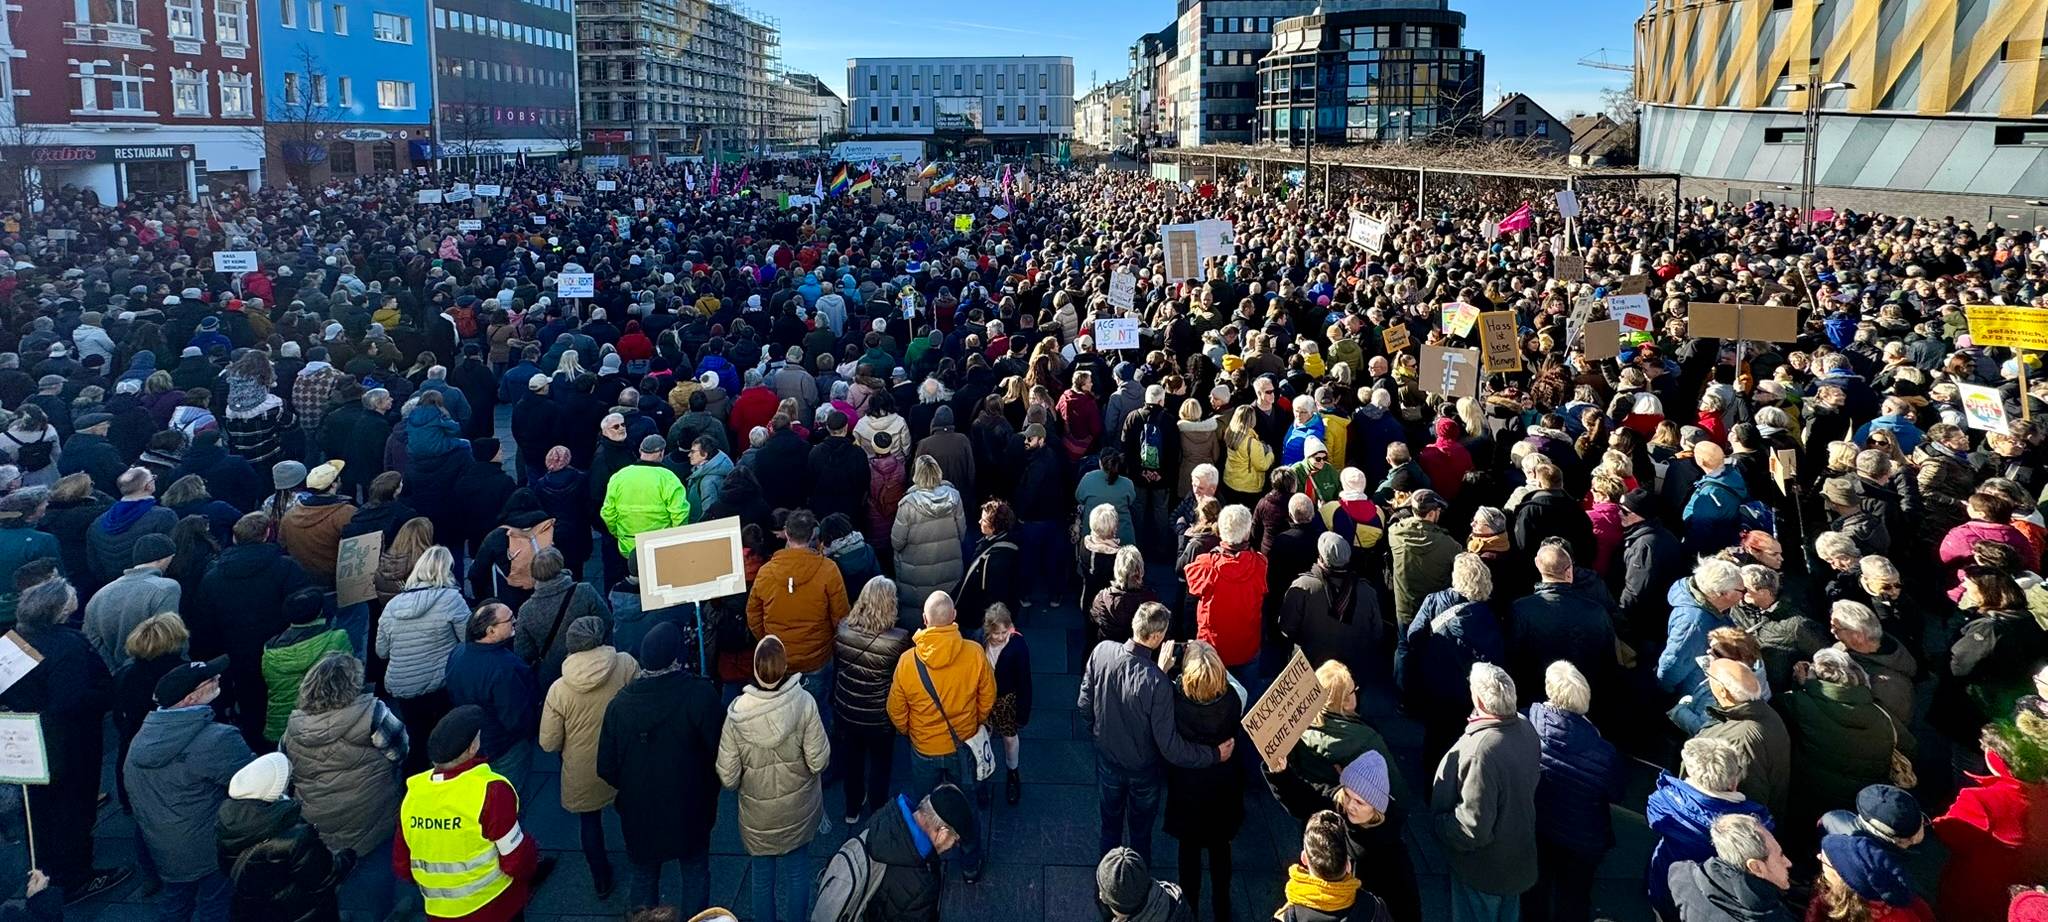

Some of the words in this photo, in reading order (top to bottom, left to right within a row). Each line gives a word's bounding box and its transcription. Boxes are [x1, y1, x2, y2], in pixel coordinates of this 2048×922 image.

[496, 111, 535, 121] JOBS
[114, 147, 174, 159] RESTAURANT
[1097, 320, 1115, 331] ACG
[1486, 320, 1512, 332] Hass
[1245, 656, 1309, 737] MENSCHENRECHTE
[1277, 689, 1300, 721] STATT
[1264, 723, 1291, 759] RECHTE
[1288, 683, 1322, 728] MENSCHEN
[410, 816, 462, 830] ORDNER
